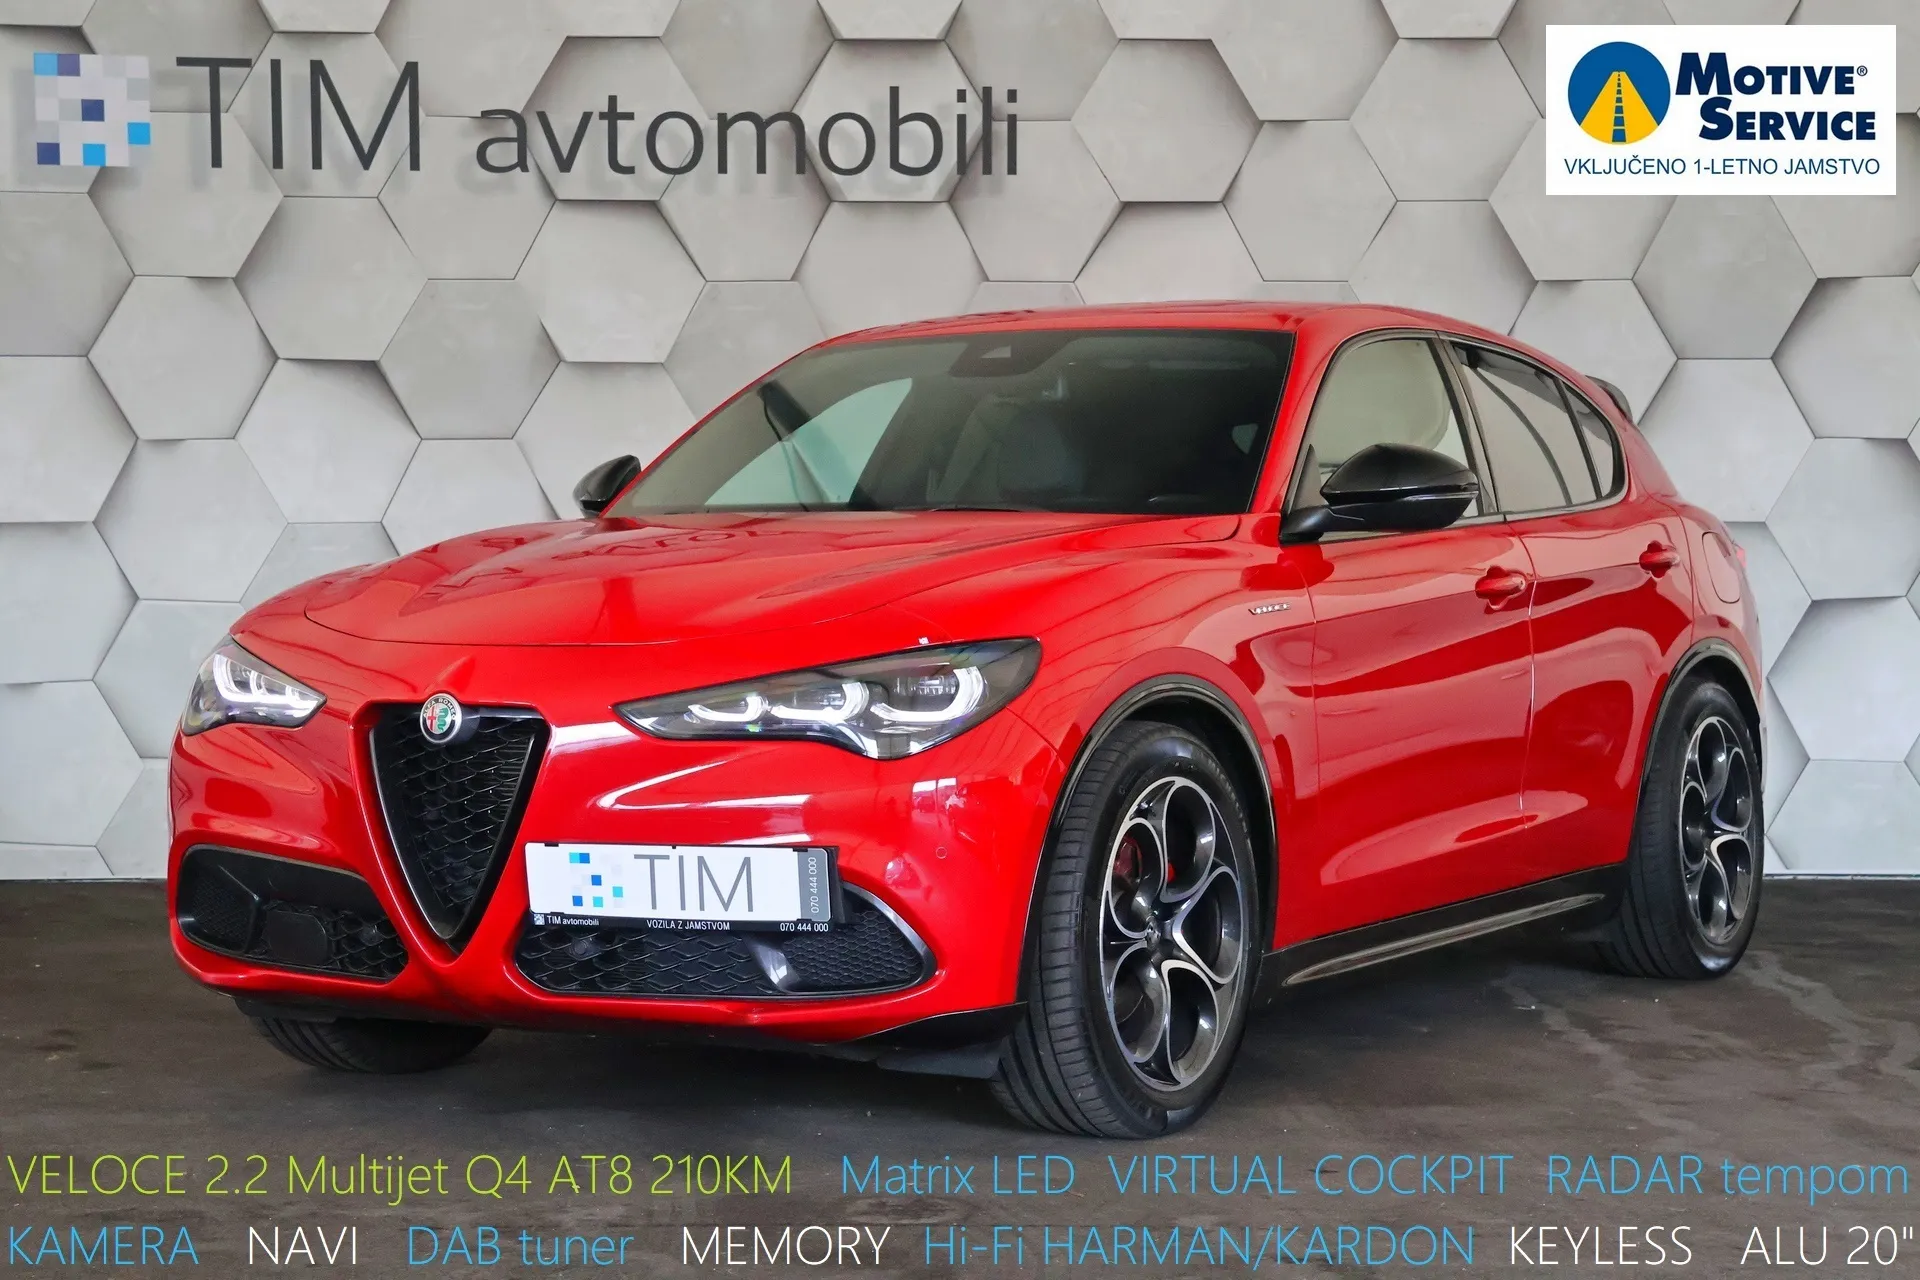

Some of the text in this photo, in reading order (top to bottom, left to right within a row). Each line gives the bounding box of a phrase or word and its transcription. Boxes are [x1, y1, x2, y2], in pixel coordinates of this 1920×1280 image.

[176, 56, 1020, 178] TIM avtomobili
[633, 853, 754, 912] TIM
[808, 856, 820, 914] 070 444 000
[546, 915, 600, 926] TIM avtomobili
[646, 919, 731, 931] VOZILA Z JAMSTVOM
[779, 922, 829, 932] 070 444 000
